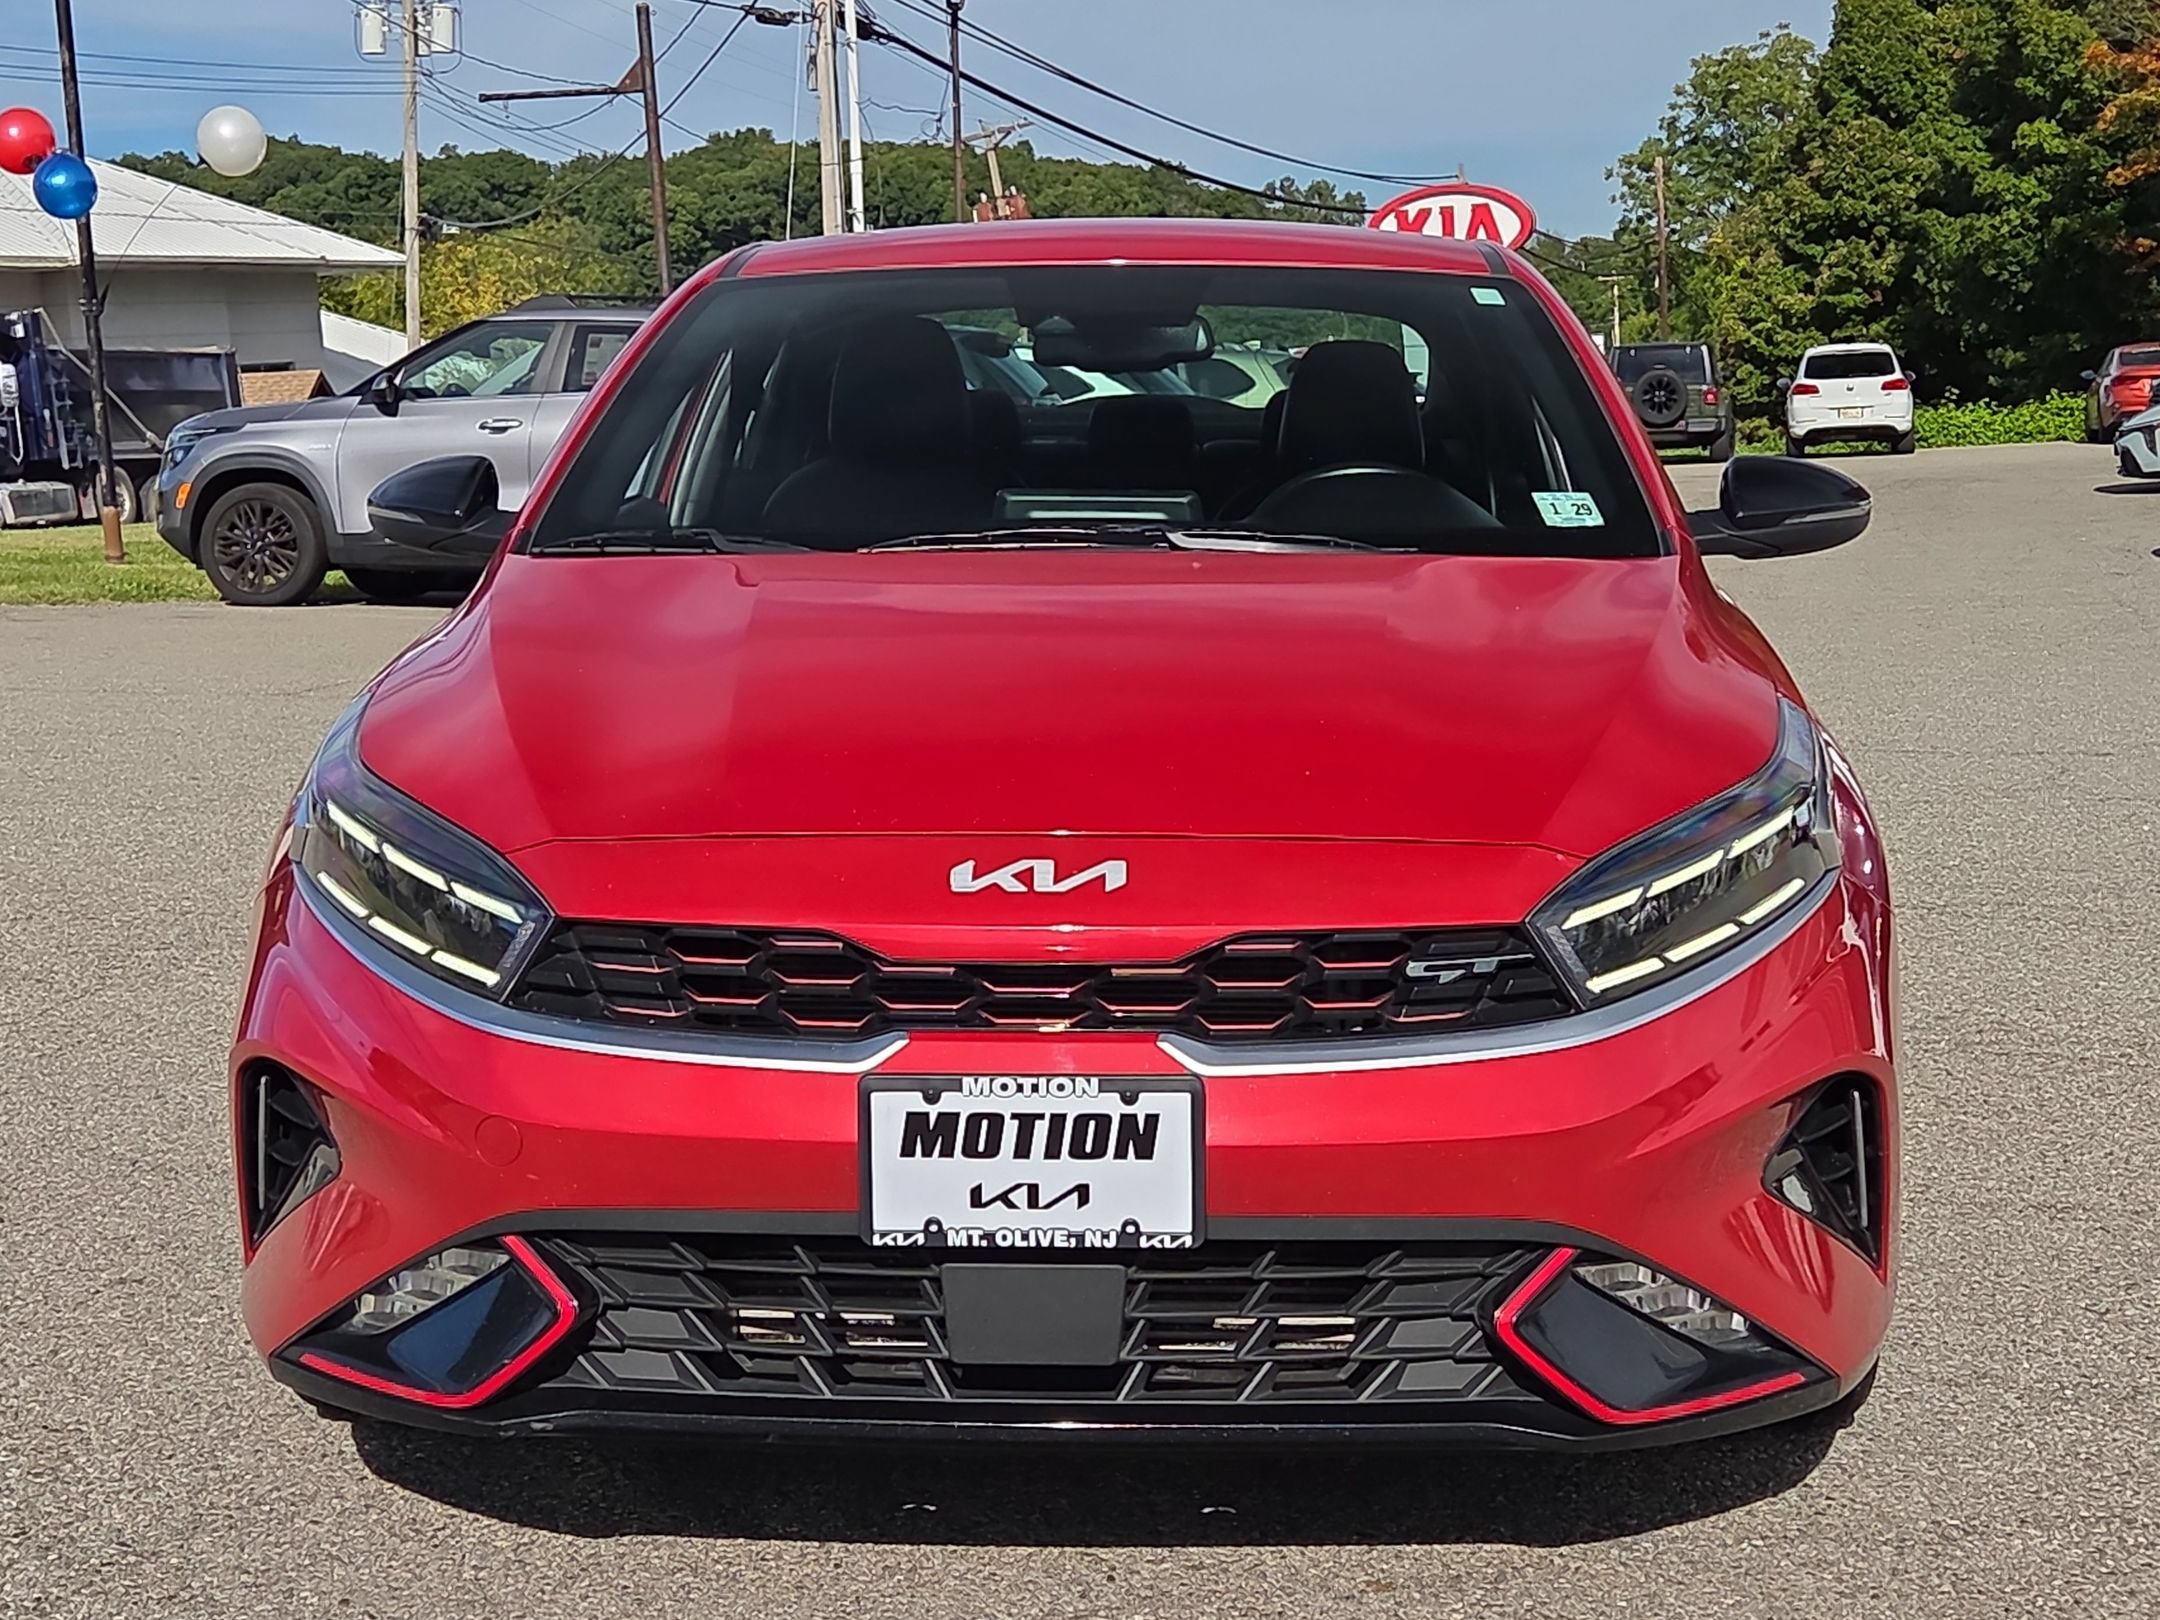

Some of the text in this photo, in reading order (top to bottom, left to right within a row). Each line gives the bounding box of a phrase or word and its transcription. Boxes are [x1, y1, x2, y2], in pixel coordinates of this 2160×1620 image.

[1549, 502, 1593, 516] 1 29
[1406, 953, 1536, 984] GT
[961, 1076, 1099, 1098] MOTION
[899, 1111, 1161, 1160] MOTION
[970, 1182, 1091, 1210] KIA
[947, 1229, 1117, 1249] MT. OLIVE, NJ
